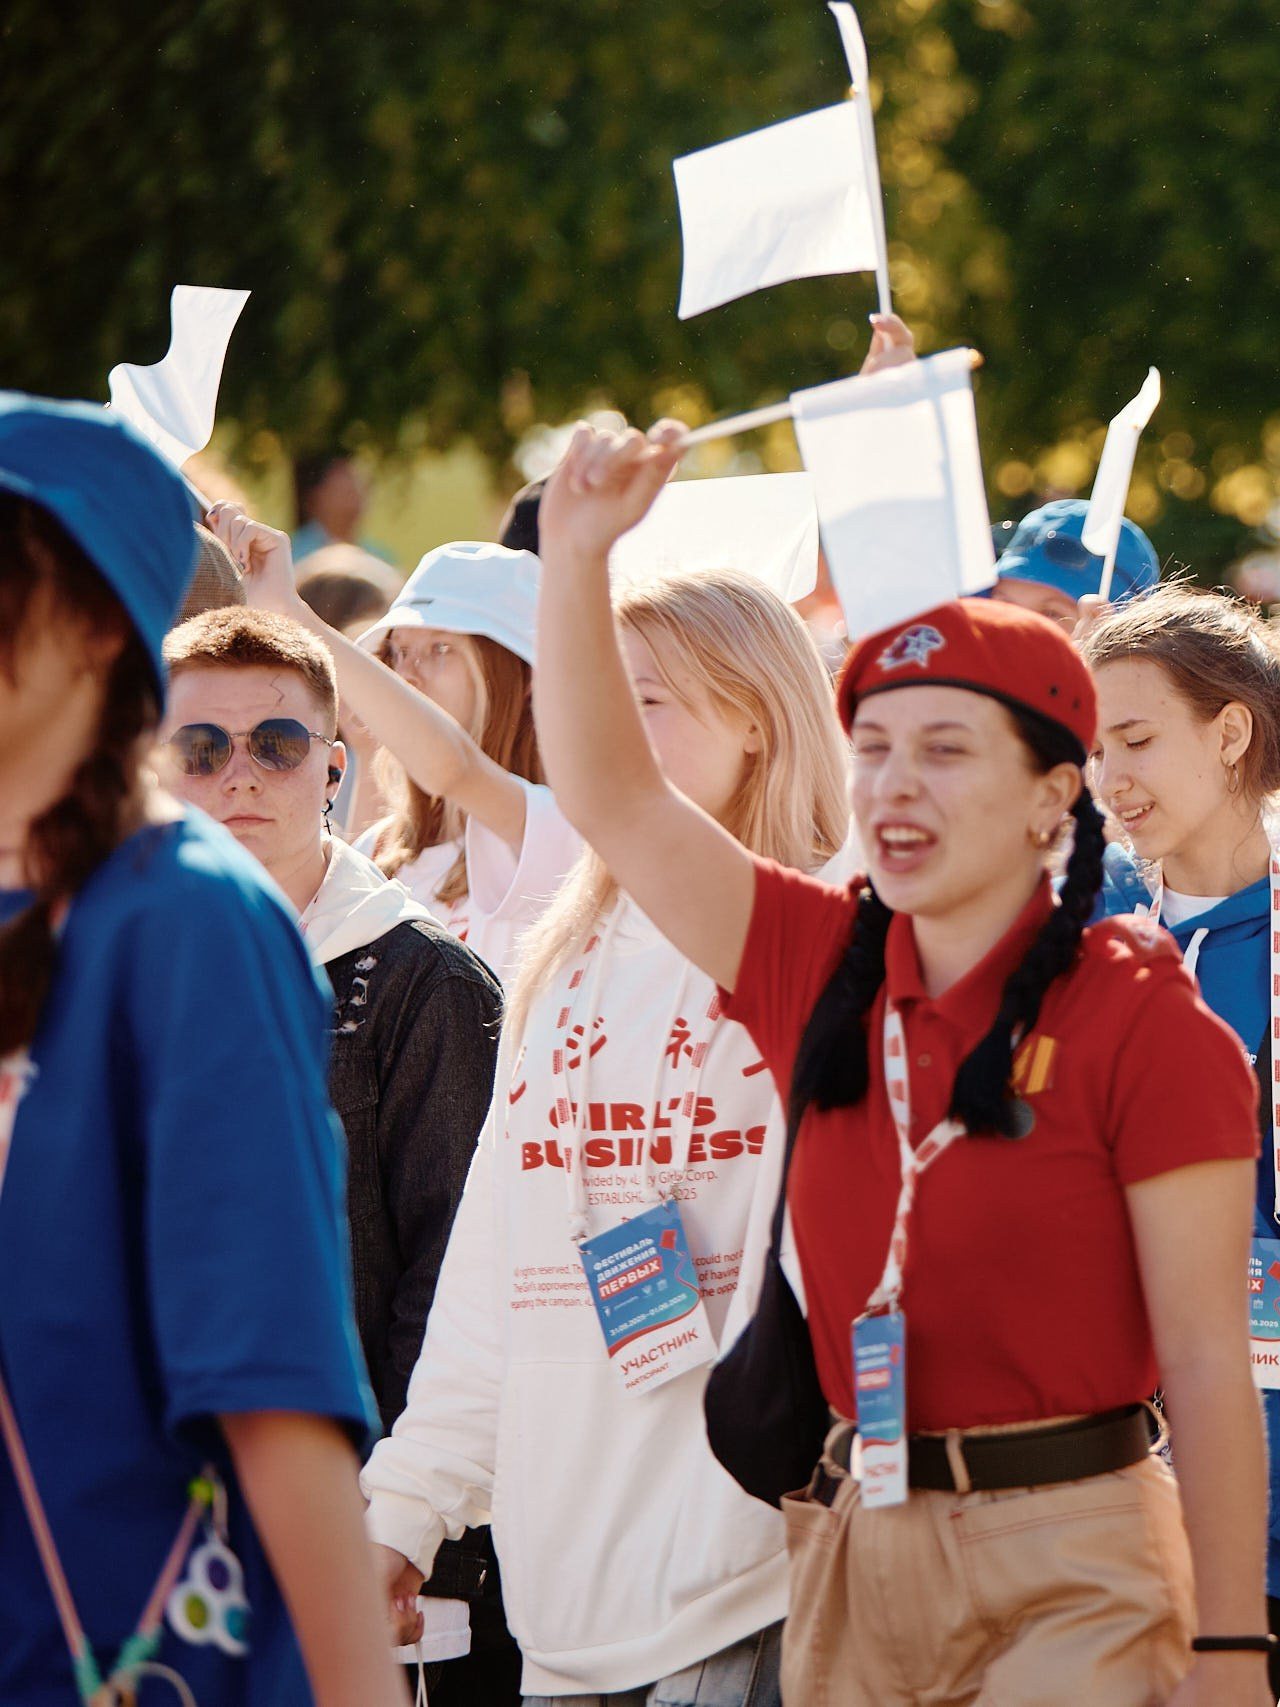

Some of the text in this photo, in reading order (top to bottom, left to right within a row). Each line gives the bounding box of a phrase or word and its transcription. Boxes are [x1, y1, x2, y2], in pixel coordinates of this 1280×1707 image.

[593, 1237, 654, 1271] ФЕСТИВАЛЬ
[596, 1247, 657, 1283] ДВИЖЕНИЯ
[600, 1260, 661, 1297] ПЕРВЫХ
[620, 1328, 699, 1376] УЧАСТНИК
[625, 1362, 670, 1389] PARTICIPANT
